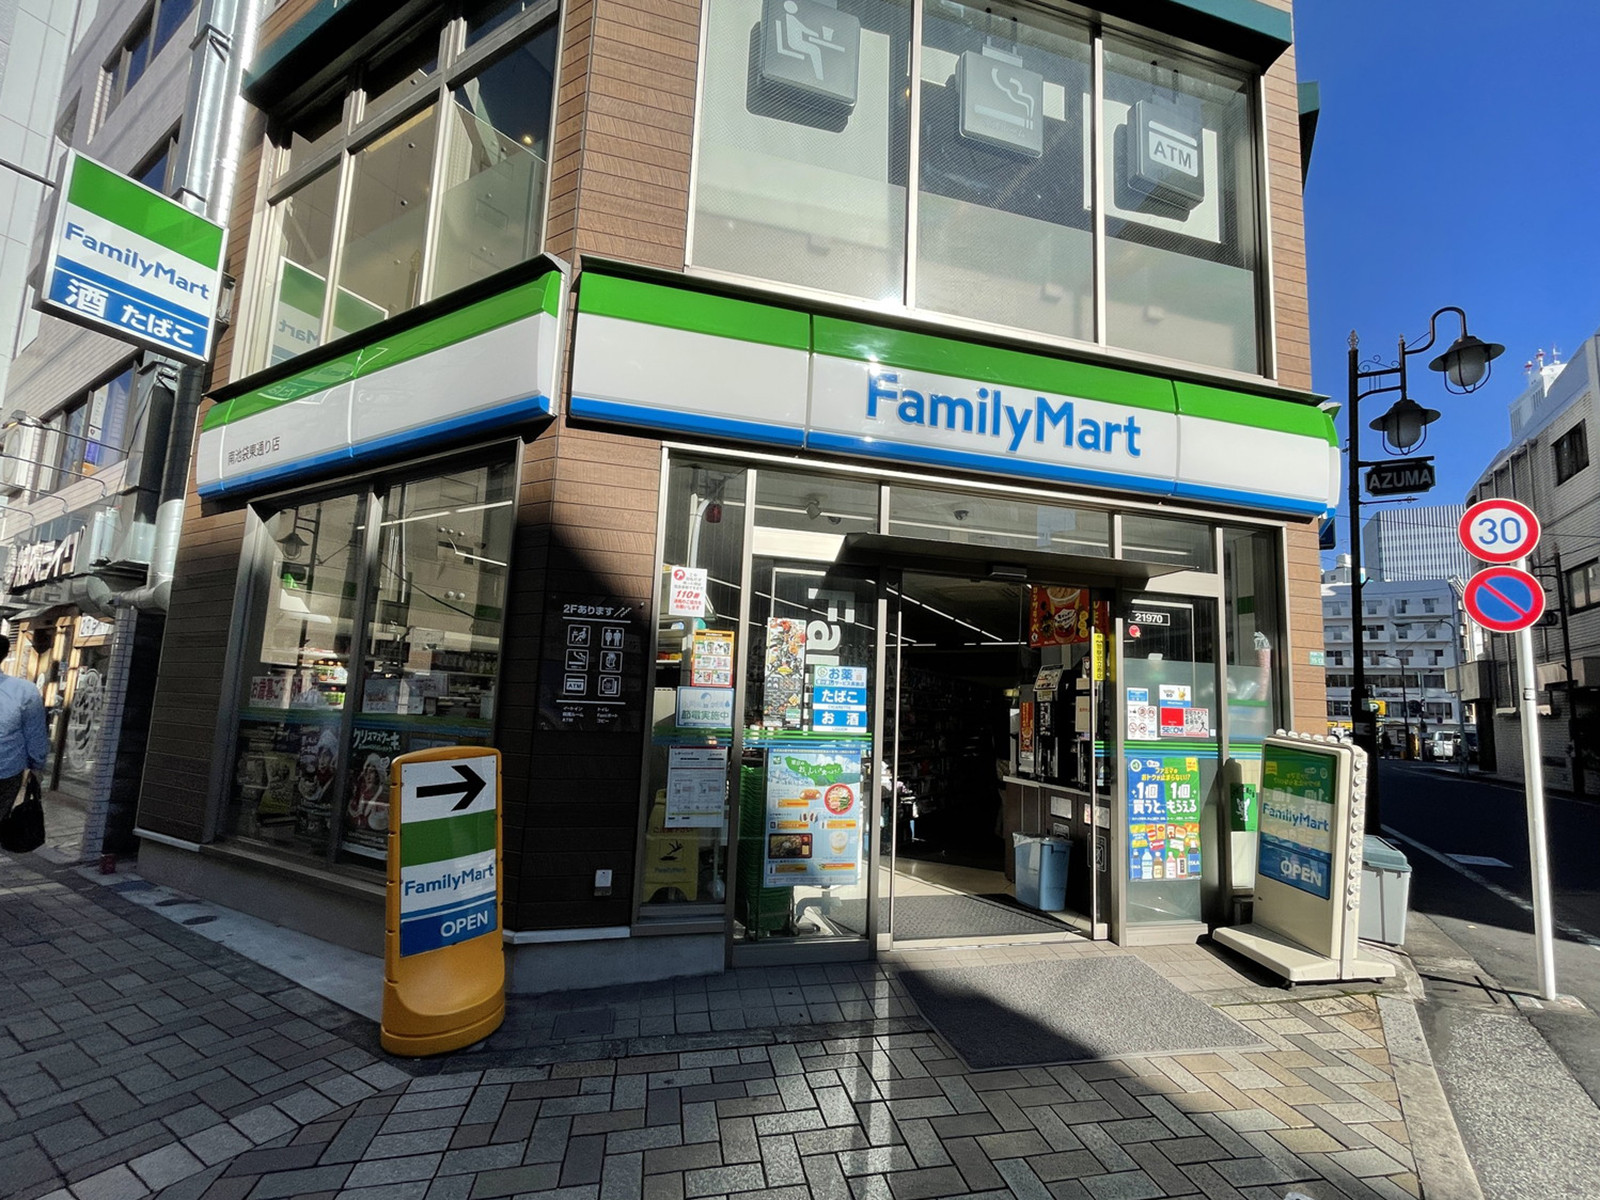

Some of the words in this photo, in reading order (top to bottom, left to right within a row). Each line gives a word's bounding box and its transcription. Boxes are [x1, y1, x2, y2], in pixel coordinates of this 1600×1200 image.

[1153, 140, 1192, 169] ATM
[65, 222, 209, 301] FamilyMart
[65, 278, 109, 319] 酒
[122, 304, 194, 348] たばこ
[866, 368, 1141, 457] FamilyMart
[228, 436, 280, 466] 南池袋東通り店
[1368, 468, 1433, 490] AZUMA
[1478, 517, 1522, 545] 30
[563, 604, 614, 616] 2Fあります
[1135, 613, 1163, 623] 21970
[829, 668, 853, 681] お薬
[821, 689, 858, 703] たばこ
[353, 727, 400, 750] クリスマスケーキ
[1162, 726, 1184, 734] SECOM
[1136, 782, 1158, 799] 1個
[1170, 782, 1190, 799] 1個
[1133, 800, 1165, 814] 買うと、
[1166, 800, 1197, 814] もらえる
[1263, 803, 1329, 833] FamilyMart
[405, 864, 494, 896] FamilyMart
[1280, 859, 1323, 887] OPEN
[440, 910, 489, 937] OPEN
